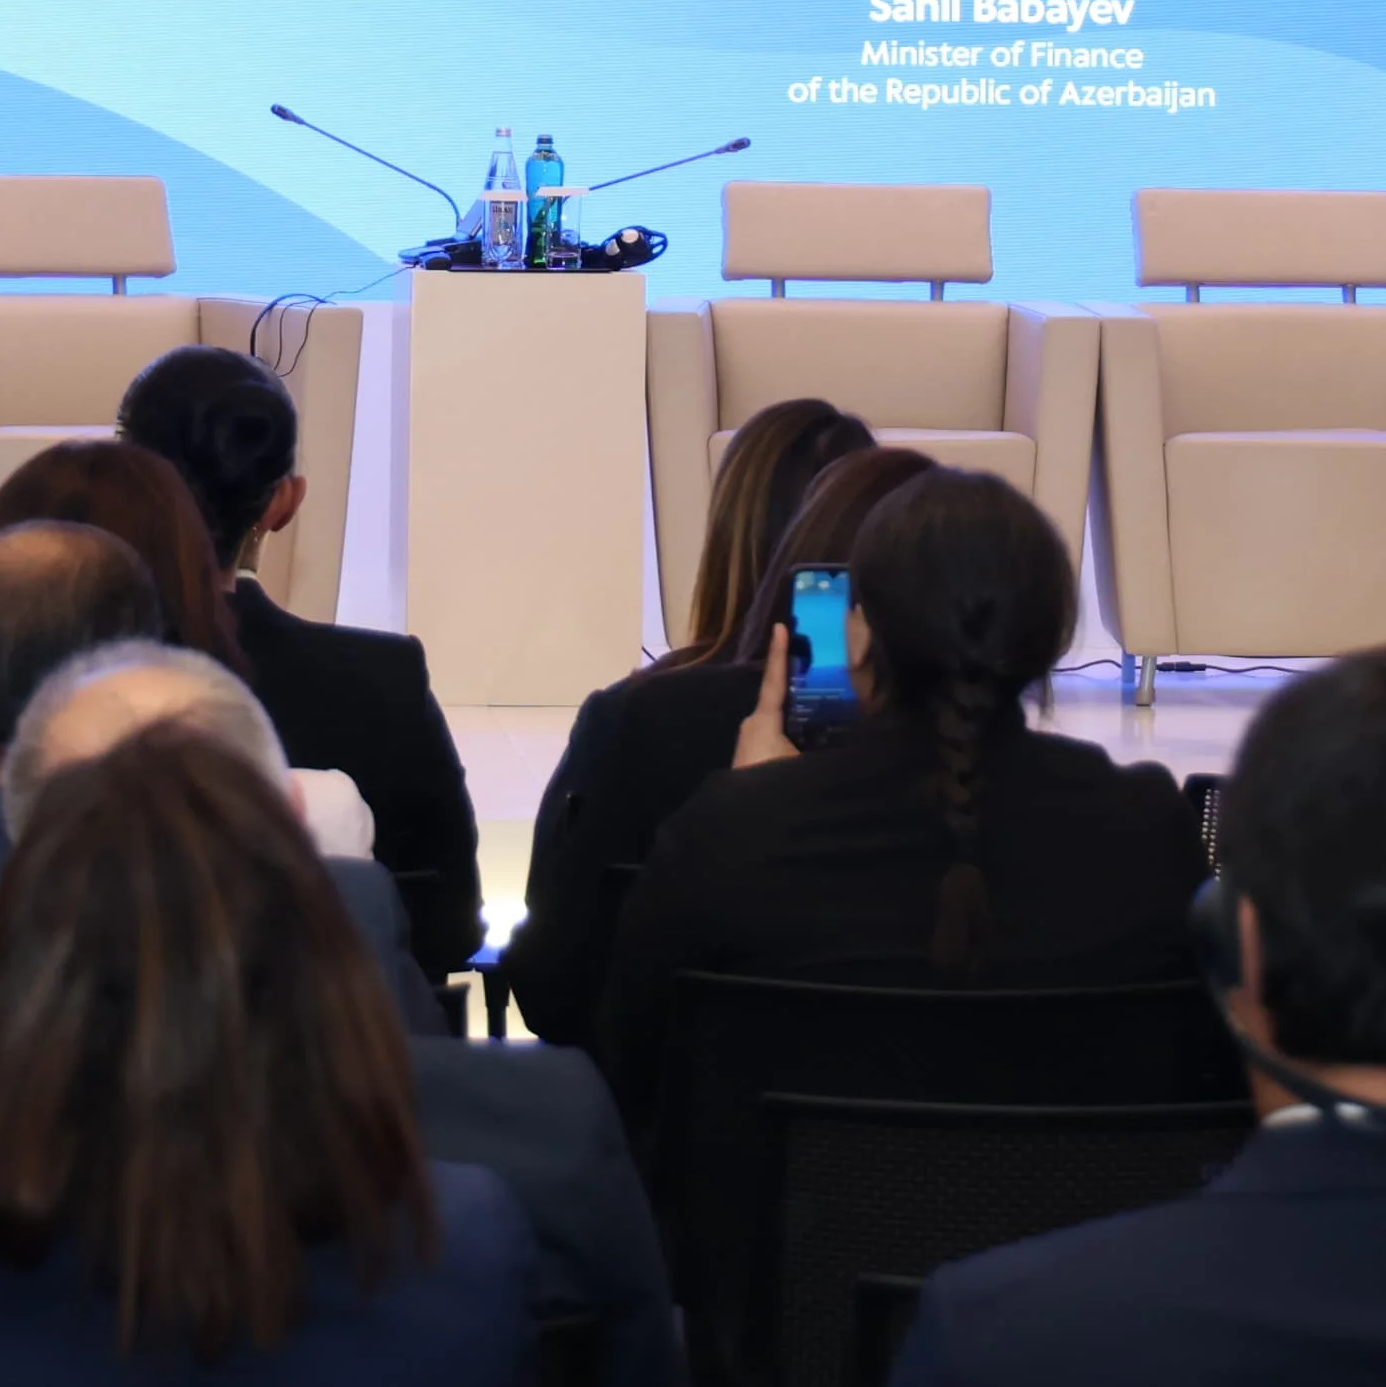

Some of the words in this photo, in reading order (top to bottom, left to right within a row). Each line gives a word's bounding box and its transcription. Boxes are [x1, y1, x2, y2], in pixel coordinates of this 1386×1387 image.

[860, 40, 983, 68] Minister
[990, 40, 1025, 68] of
[1031, 41, 1145, 69] Finance
[788, 76, 823, 104] of
[828, 77, 878, 104] the
[886, 77, 1011, 110] Republic
[1019, 78, 1053, 106] of
[1059, 80, 1216, 114] Azerbaijan
